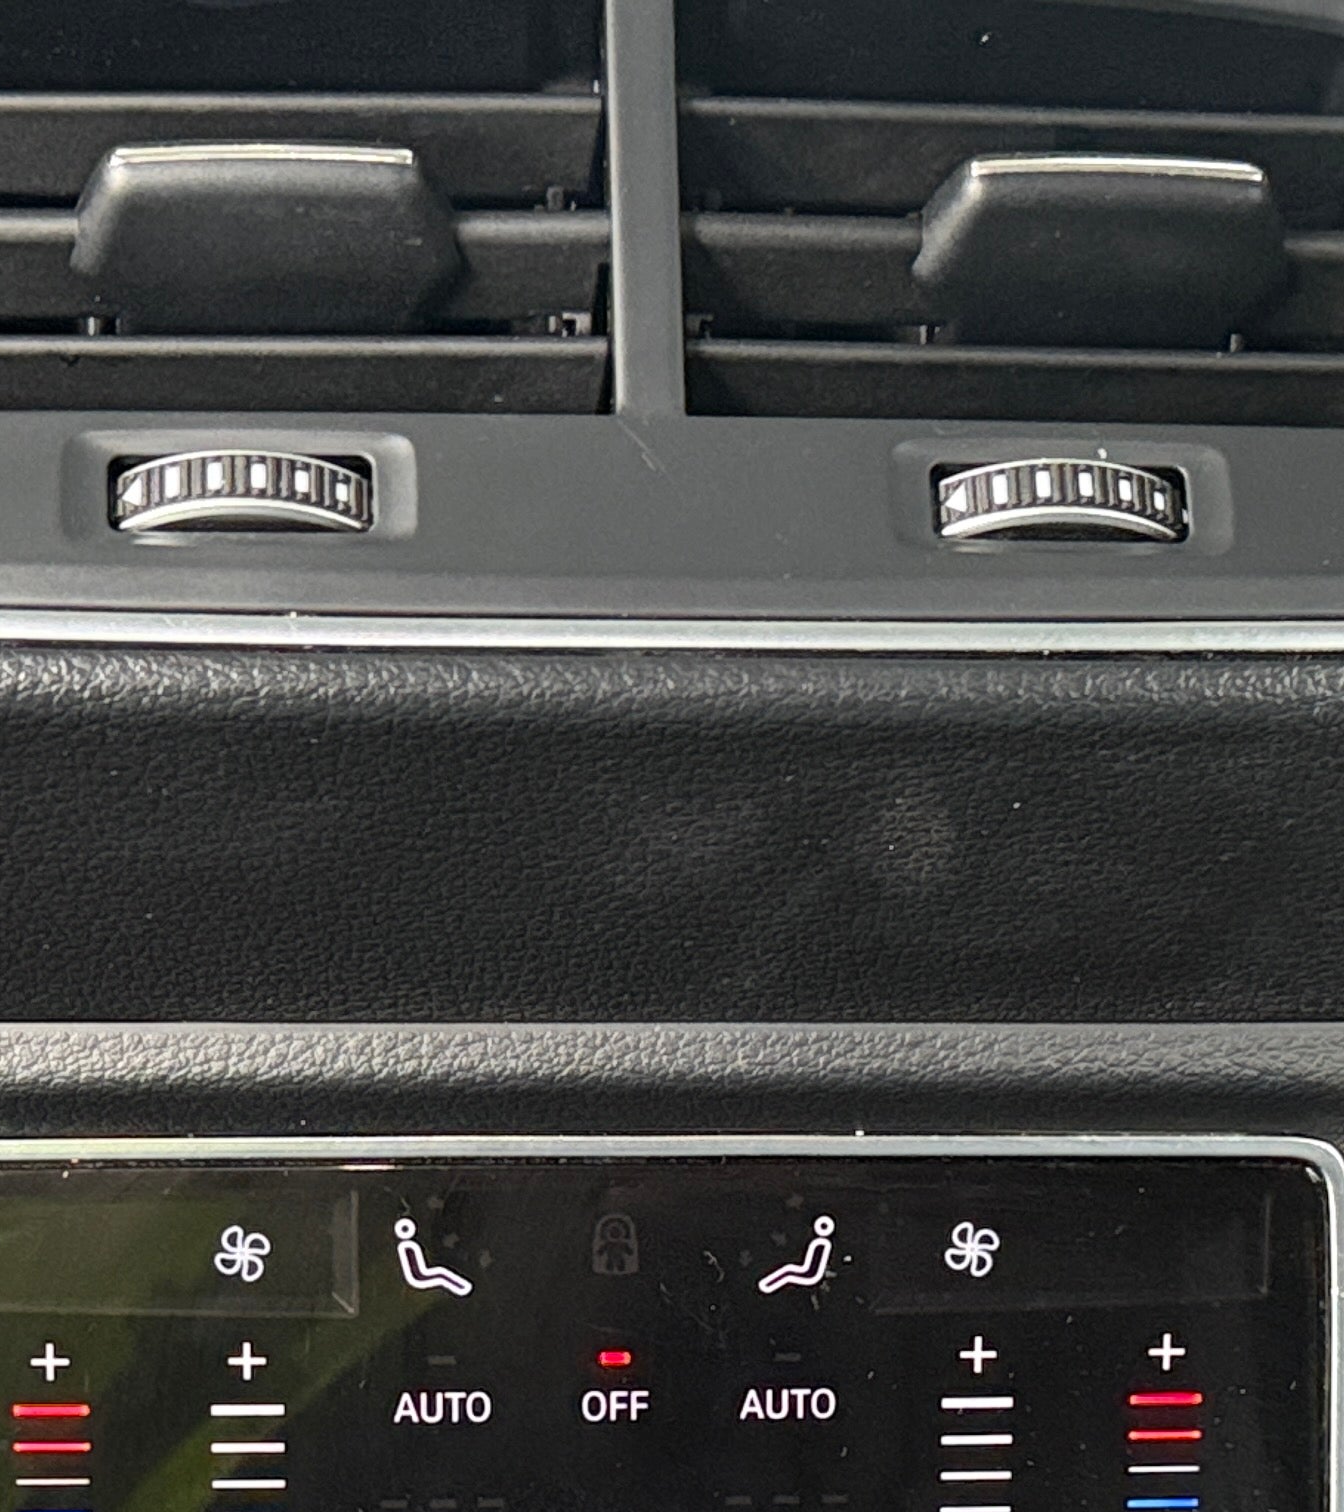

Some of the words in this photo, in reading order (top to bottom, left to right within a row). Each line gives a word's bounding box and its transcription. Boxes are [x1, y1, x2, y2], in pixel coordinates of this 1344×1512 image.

[393, 1391, 492, 1424] AUTO
[581, 1389, 650, 1422] OFF
[739, 1387, 837, 1420] AUTO
